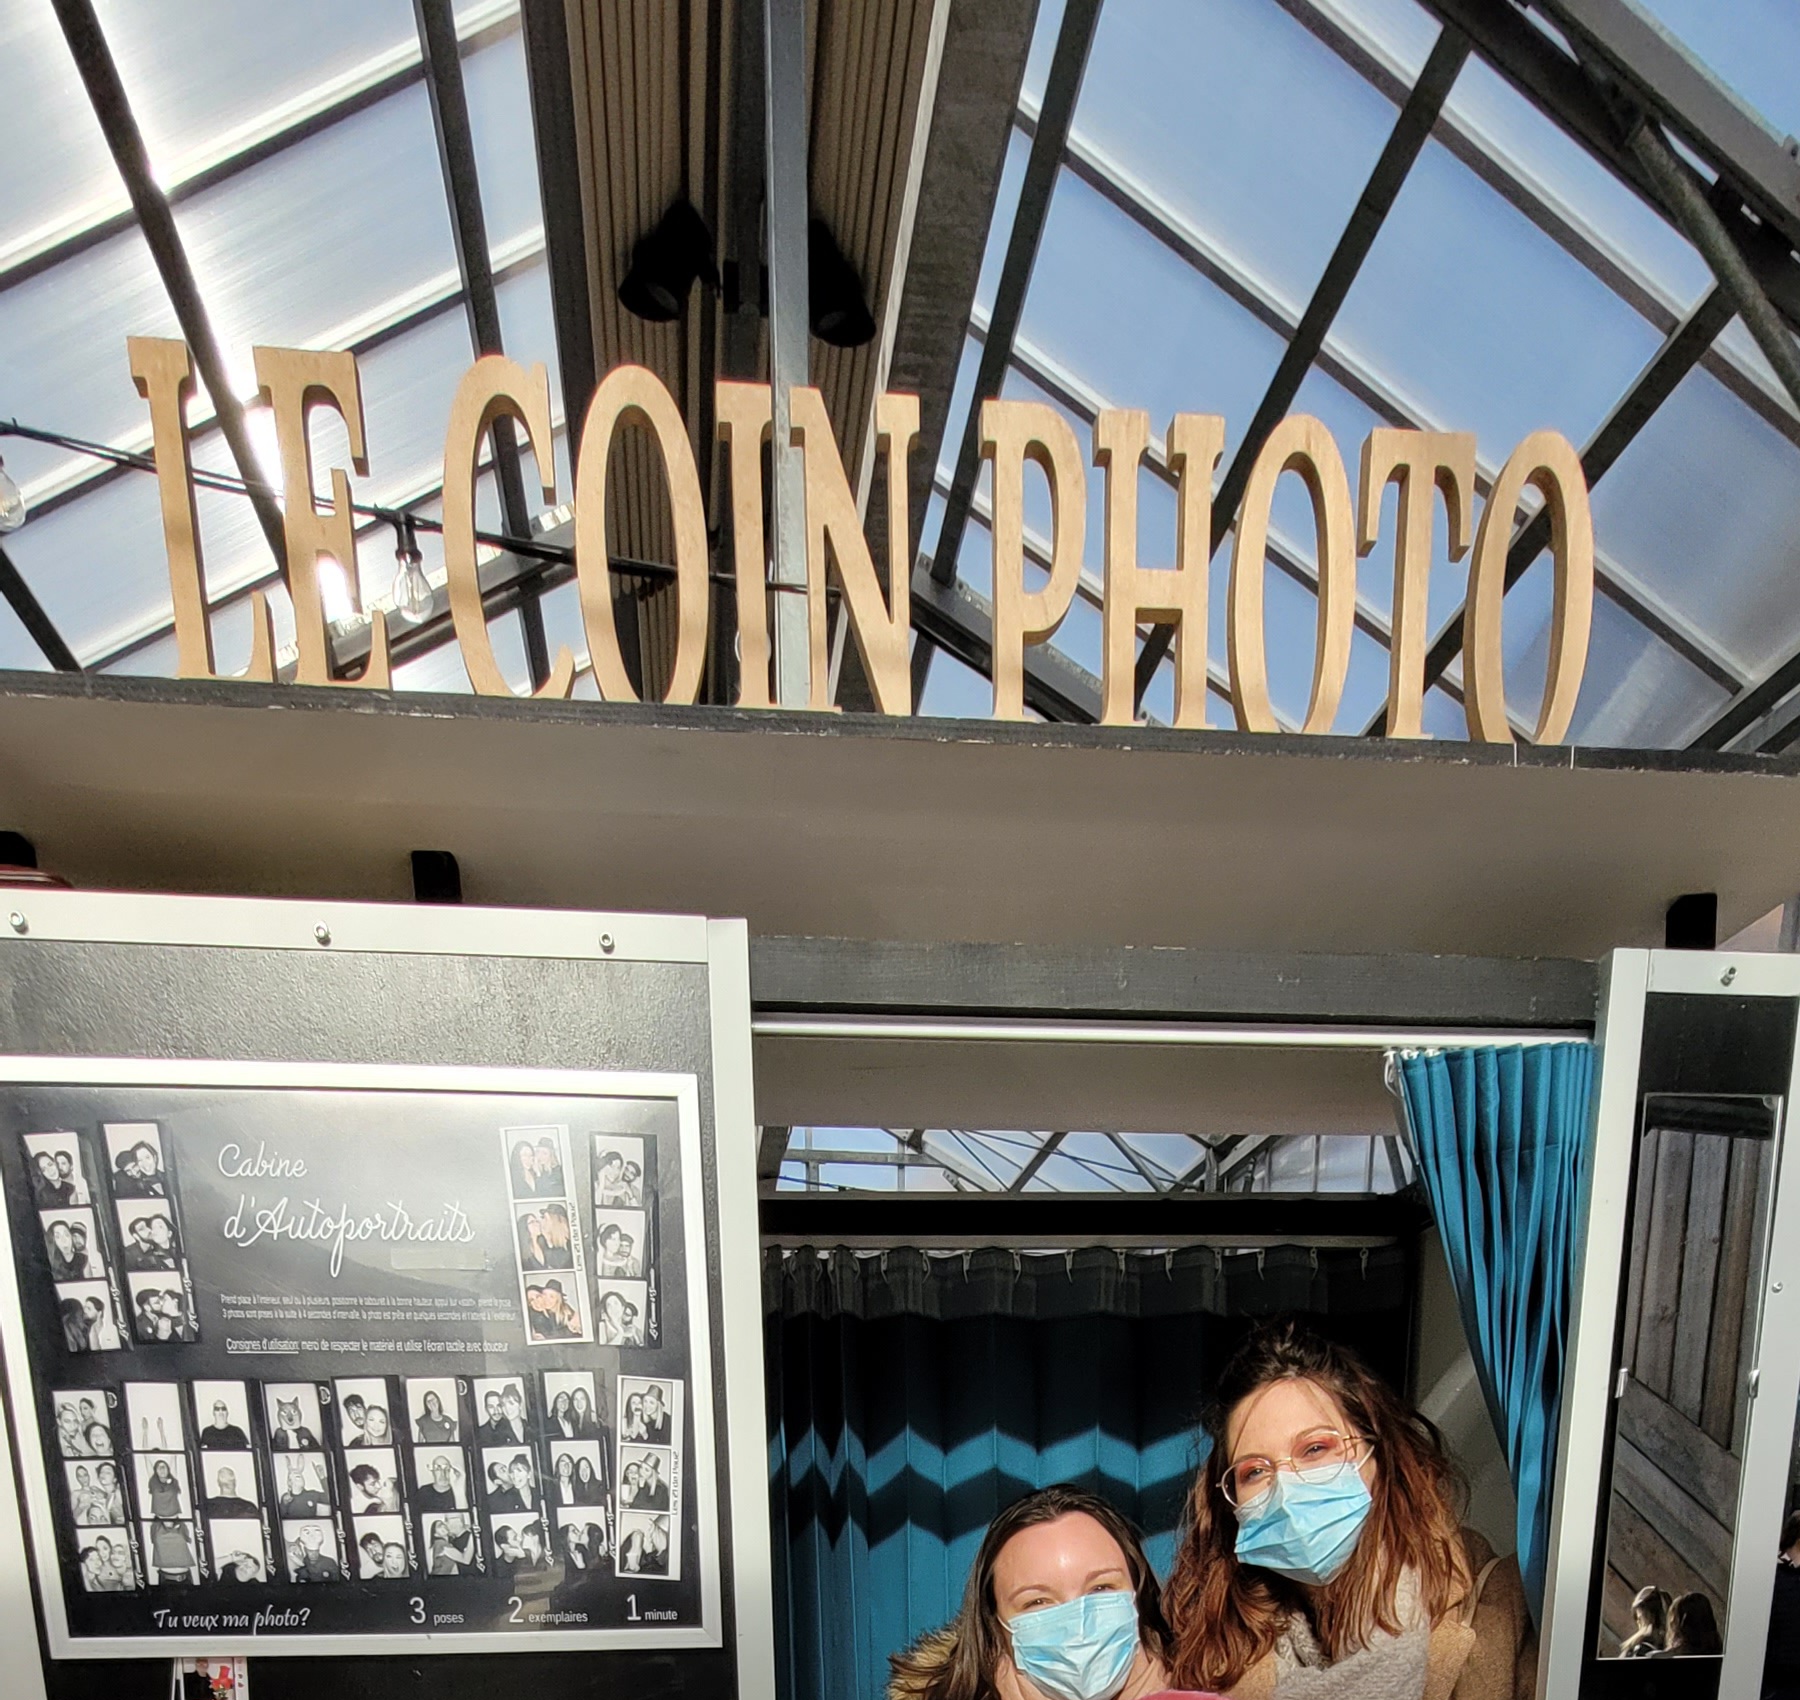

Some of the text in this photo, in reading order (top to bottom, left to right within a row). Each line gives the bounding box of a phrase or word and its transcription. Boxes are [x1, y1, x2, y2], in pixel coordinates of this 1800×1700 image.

[129, 337, 1593, 746] LE COIN PHOTO
[218, 1141, 308, 1178] Cabine
[224, 1194, 475, 1278] d'Autoportraits
[153, 1604, 311, 1635] Tu veux ma photo?
[410, 1597, 464, 1626] 3 poses
[508, 1596, 588, 1624] 2 exemplaires
[626, 1594, 678, 1621] 1 minute
